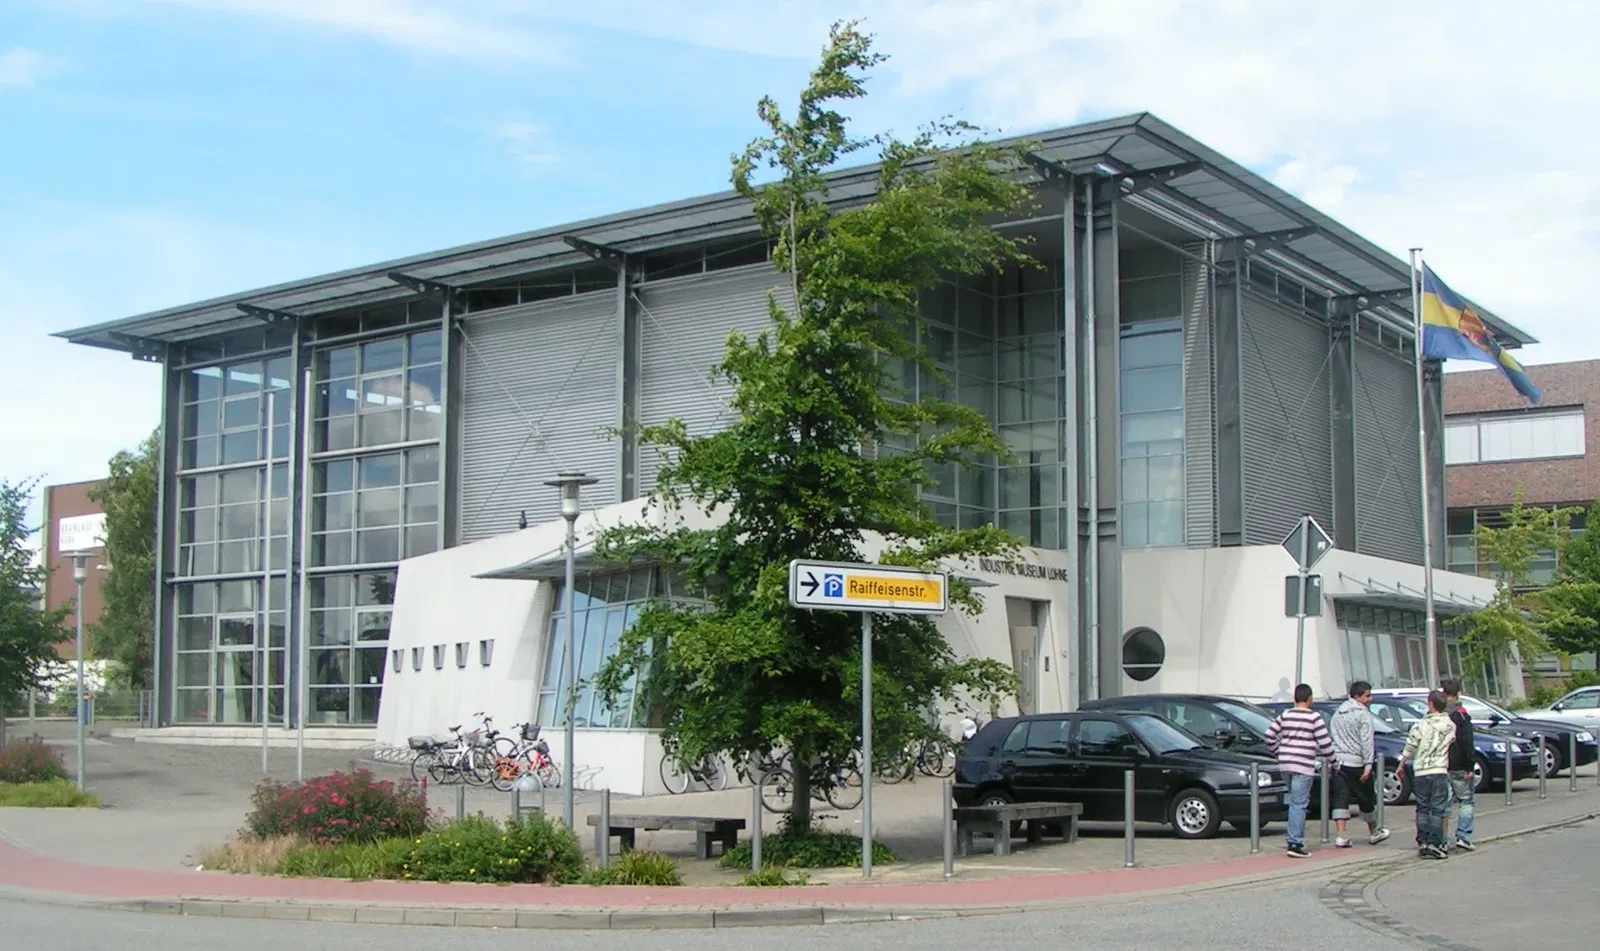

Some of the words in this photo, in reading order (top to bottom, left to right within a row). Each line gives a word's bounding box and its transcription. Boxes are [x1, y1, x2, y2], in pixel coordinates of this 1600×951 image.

[1016, 563, 1047, 579] MUSEUM
[1047, 566, 1069, 582] LOHNE
[829, 581, 839, 597] P
[849, 580, 927, 598] Raiffeisenstr.
